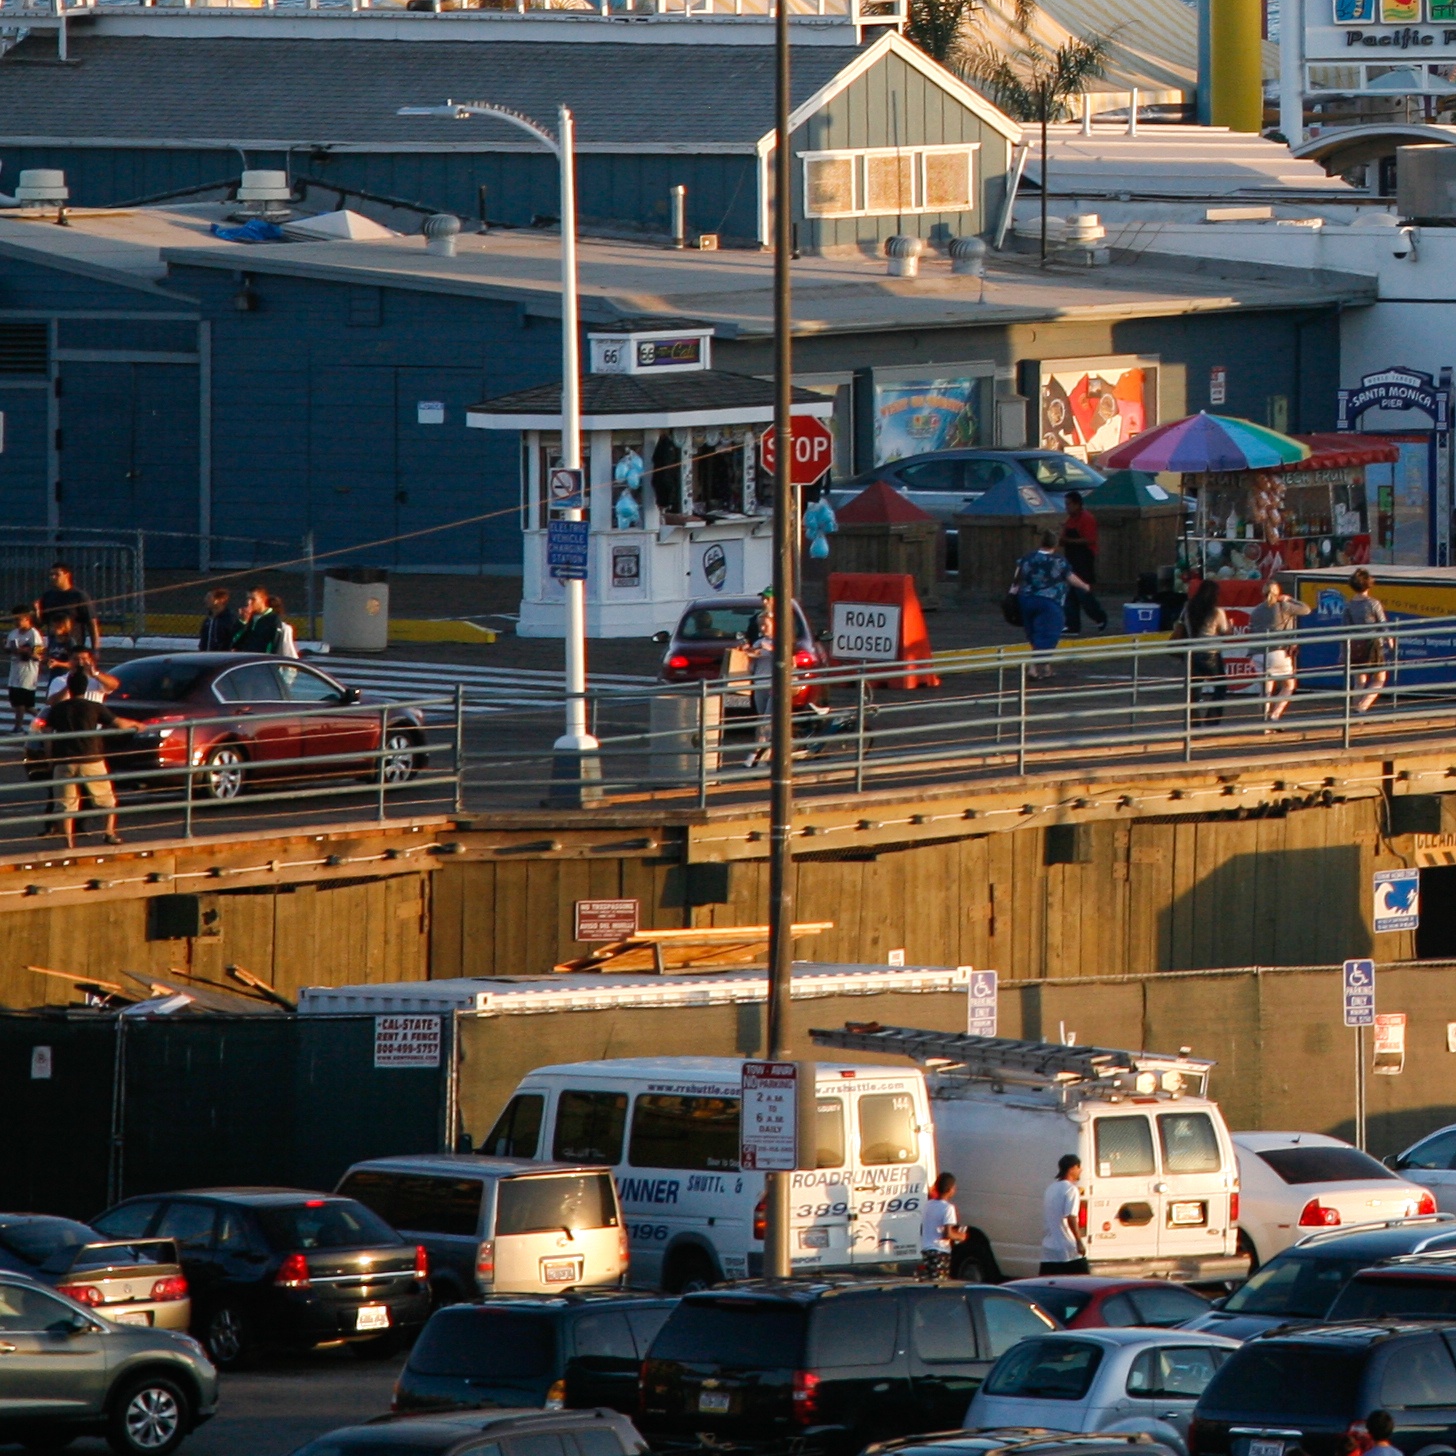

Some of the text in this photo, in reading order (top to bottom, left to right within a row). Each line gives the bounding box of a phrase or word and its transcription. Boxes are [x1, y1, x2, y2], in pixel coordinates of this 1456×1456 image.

[1347, 28, 1434, 49] Pacific
[604, 349, 618, 364] 66
[1353, 386, 1432, 407] SANTA MONICA
[1381, 399, 1404, 408] PIER
[766, 436, 829, 463] SOP
[549, 522, 588, 533] ELECTRIC
[552, 534, 585, 544] VEHICLE
[548, 544, 588, 555] CHARGING
[551, 555, 584, 564] STATION
[845, 611, 887, 628] ROAD
[837, 635, 893, 653] CLOSED
[1347, 986, 1373, 995] PARKING
[1351, 996, 1368, 1006] ONLY
[382, 1018, 433, 1031] CAL-STATE
[377, 1032, 439, 1042] RENT A FENCE
[746, 1065, 795, 1075] TOW AWAY
[744, 1075, 793, 1089] NO PARKING
[756, 1093, 763, 1102] 2
[891, 1097, 908, 1111] 144
[756, 1113, 763, 1123] 6
[792, 1166, 911, 1189] ROADRUNNER
[880, 1182, 921, 1196] SHUTTLE
[796, 1197, 920, 1218] 389-8196
